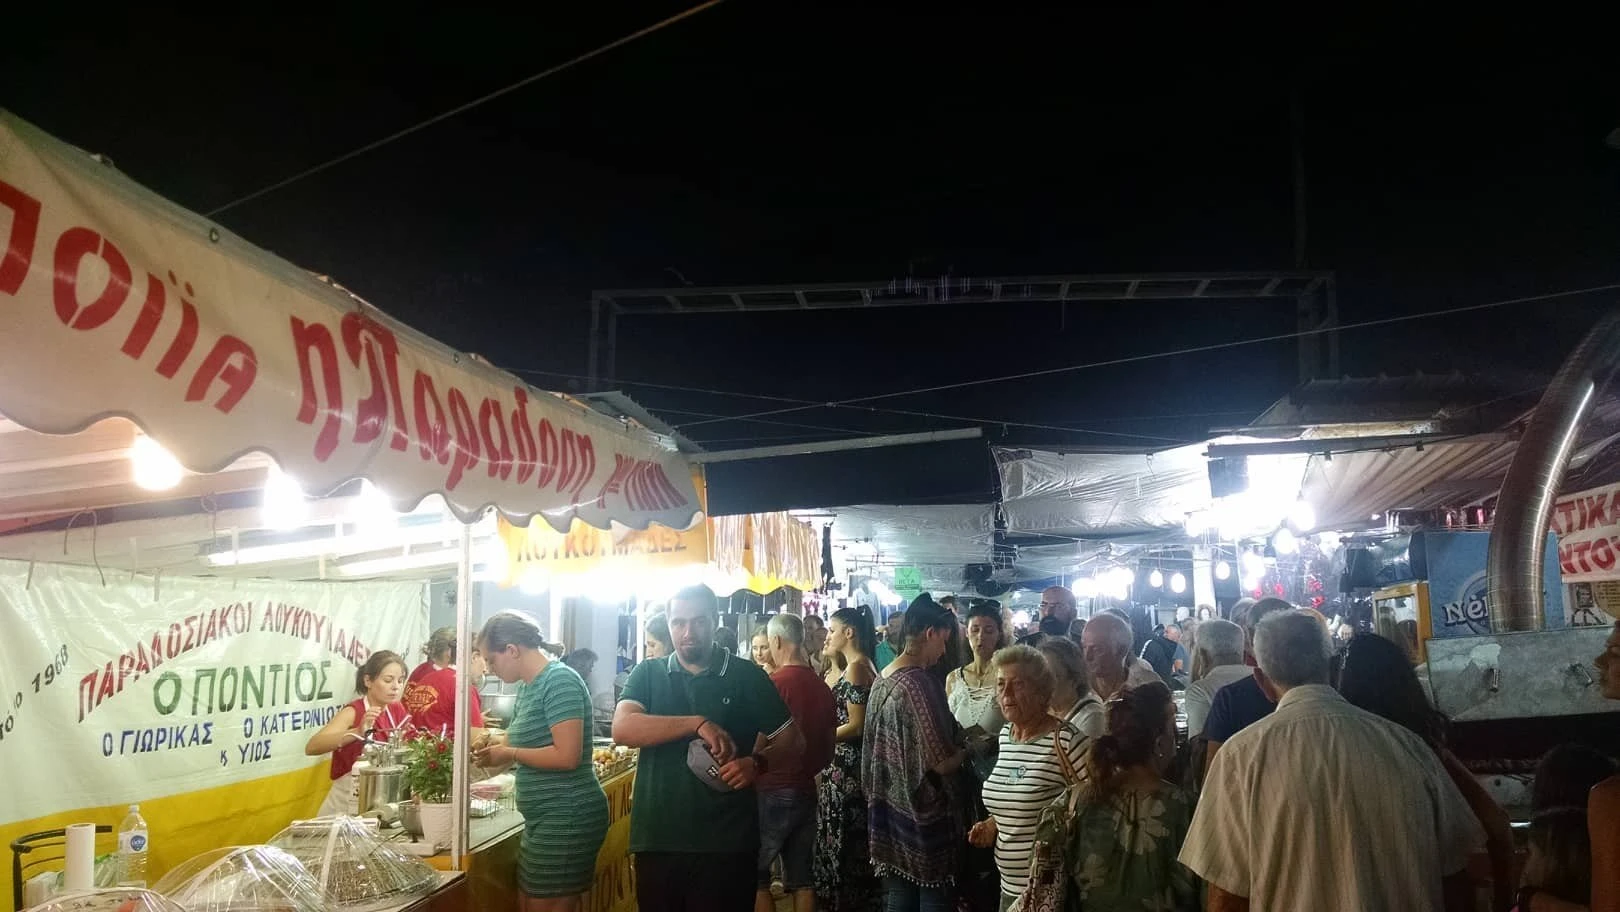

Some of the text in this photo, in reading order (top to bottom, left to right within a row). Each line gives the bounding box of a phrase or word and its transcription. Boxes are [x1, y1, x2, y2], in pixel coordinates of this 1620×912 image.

[31, 643, 68, 694] 1968
[153, 660, 333, 716] Ο ΠΟΝΤΙΟΣ
[120, 721, 213, 756] ΓΙΩΡΙΚΑΣ
[238, 739, 272, 765] ΥΙΟΣ
